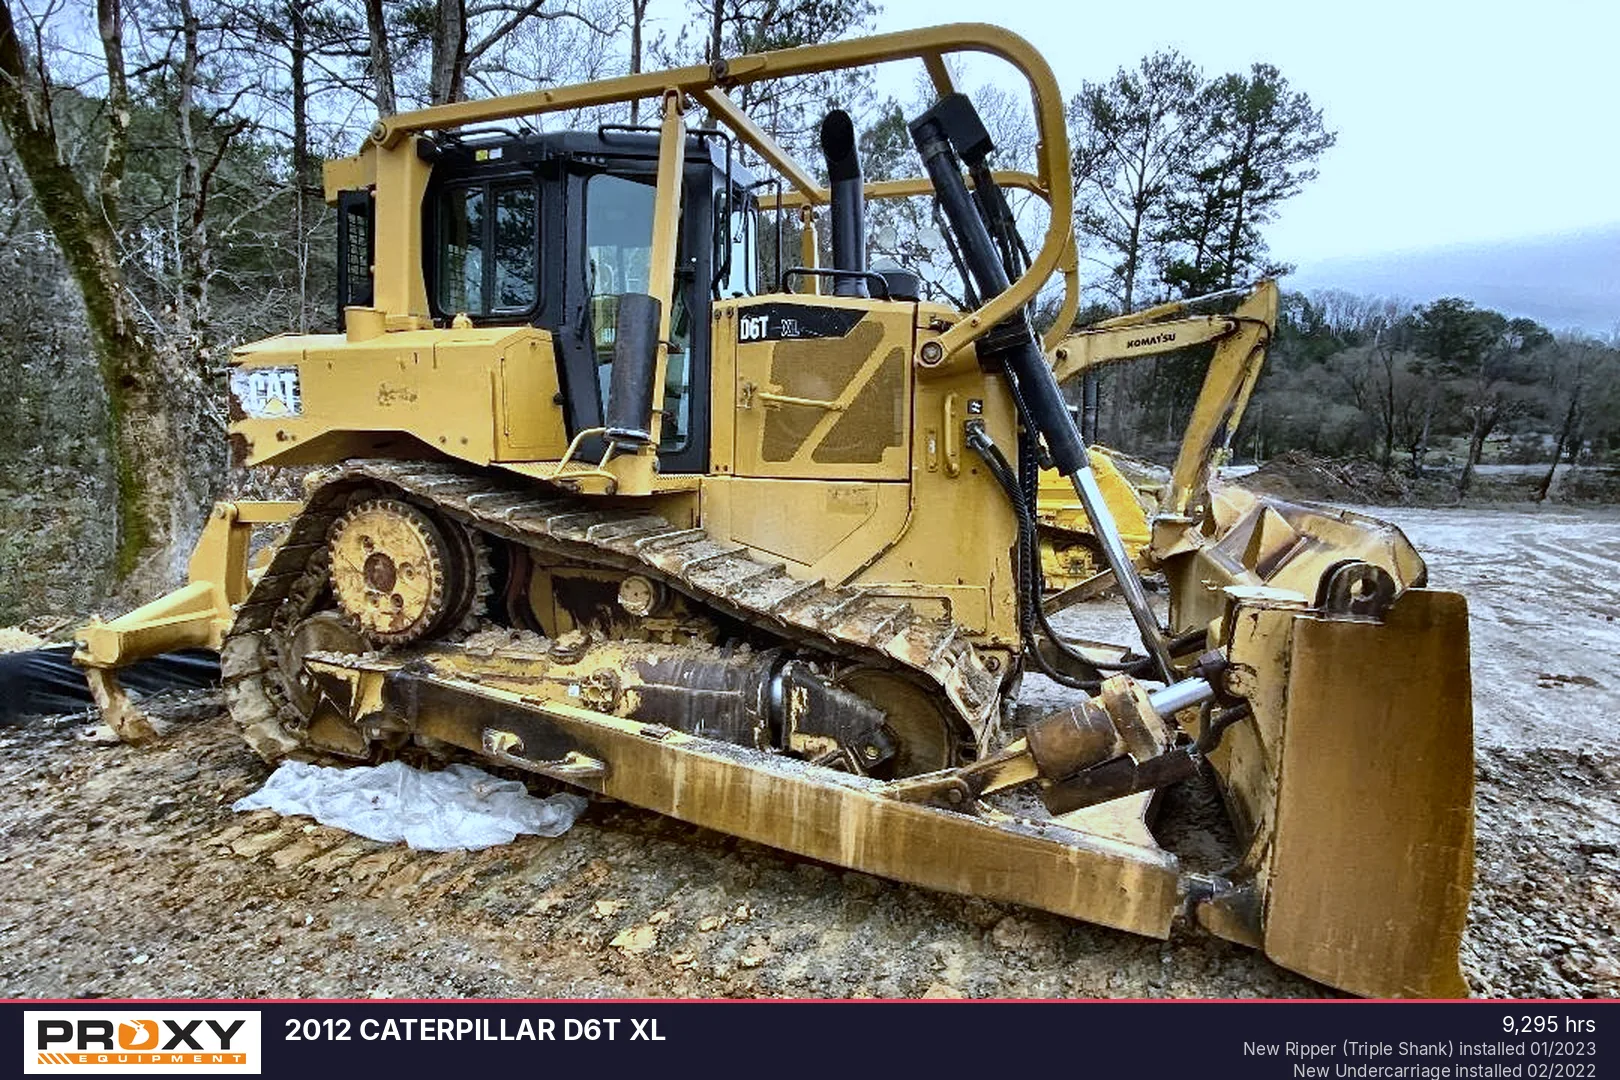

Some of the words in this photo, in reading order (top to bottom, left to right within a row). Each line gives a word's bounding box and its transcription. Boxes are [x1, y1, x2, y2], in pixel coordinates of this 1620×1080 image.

[740, 315, 769, 340] D6T
[1126, 332, 1176, 349] KOMATSU
[249, 371, 297, 412] CAT
